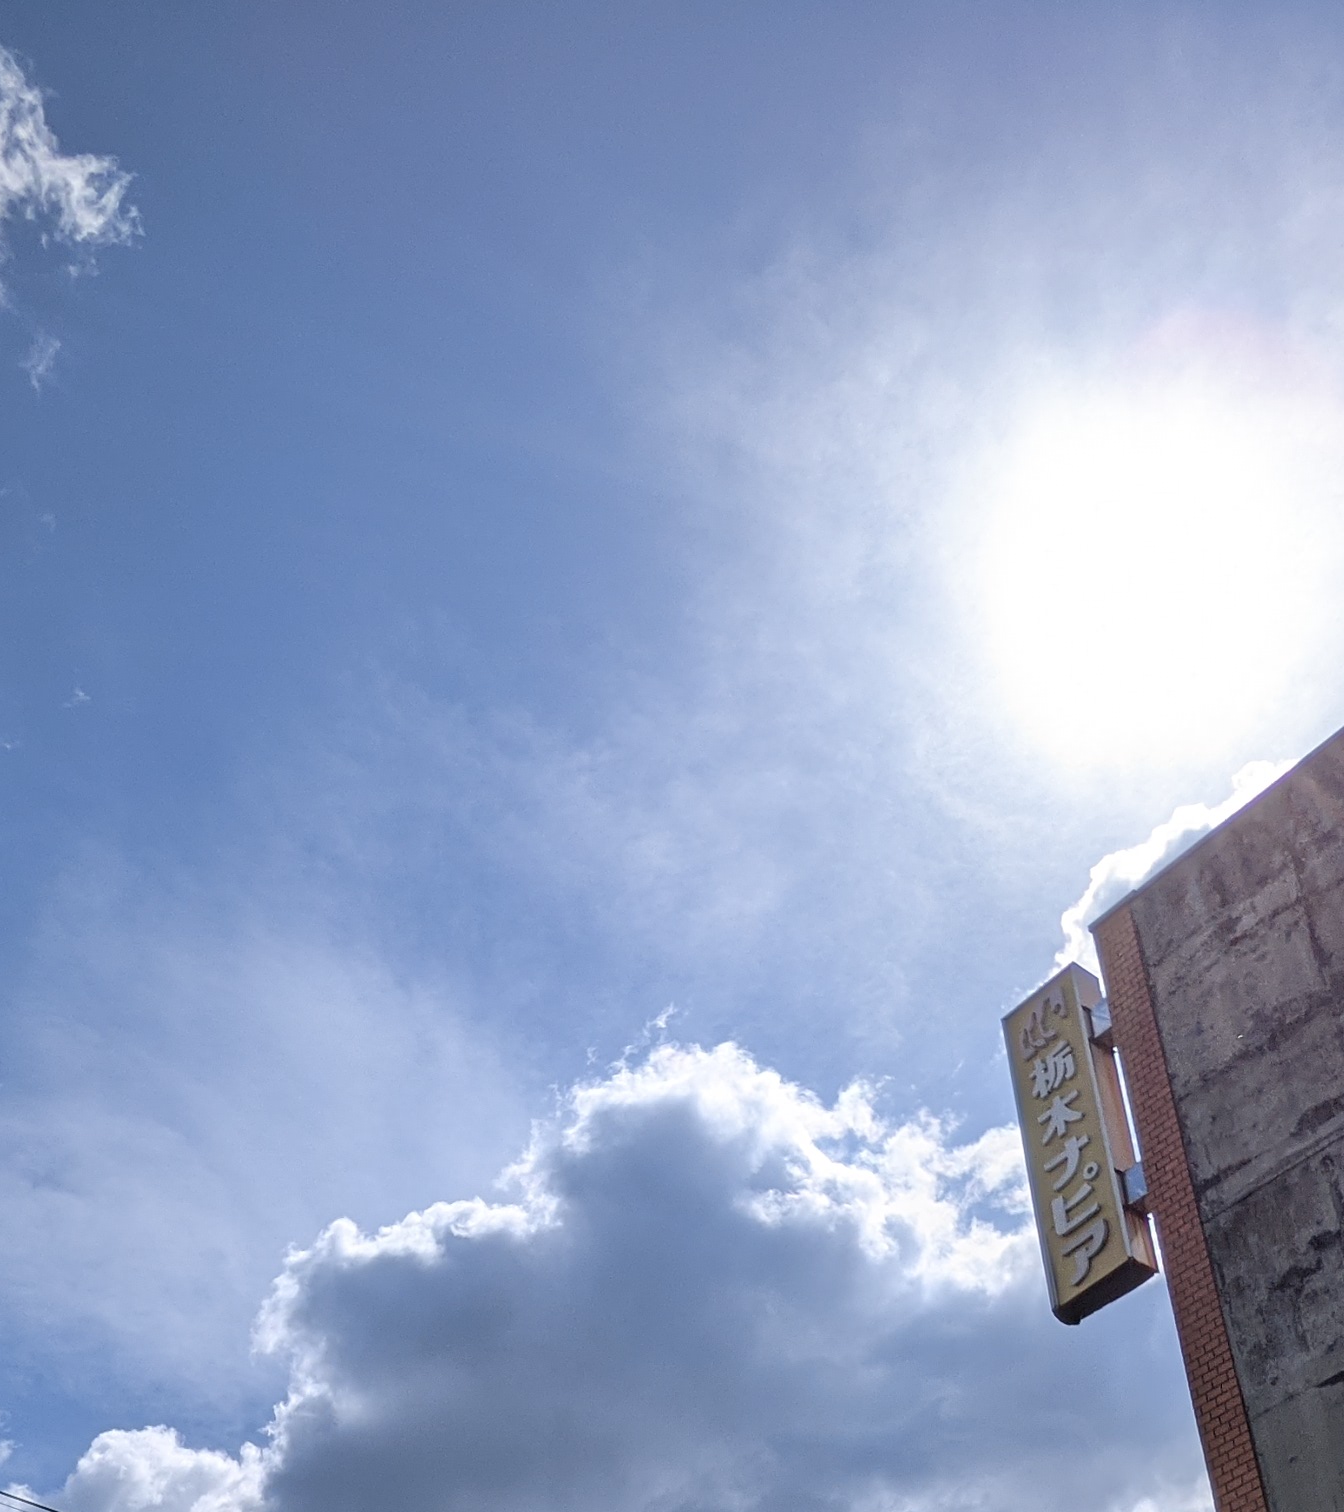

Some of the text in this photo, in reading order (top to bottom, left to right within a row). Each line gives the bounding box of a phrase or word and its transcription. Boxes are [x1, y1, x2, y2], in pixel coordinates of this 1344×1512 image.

[1028, 1040, 1110, 1286] 栃木ナピア
